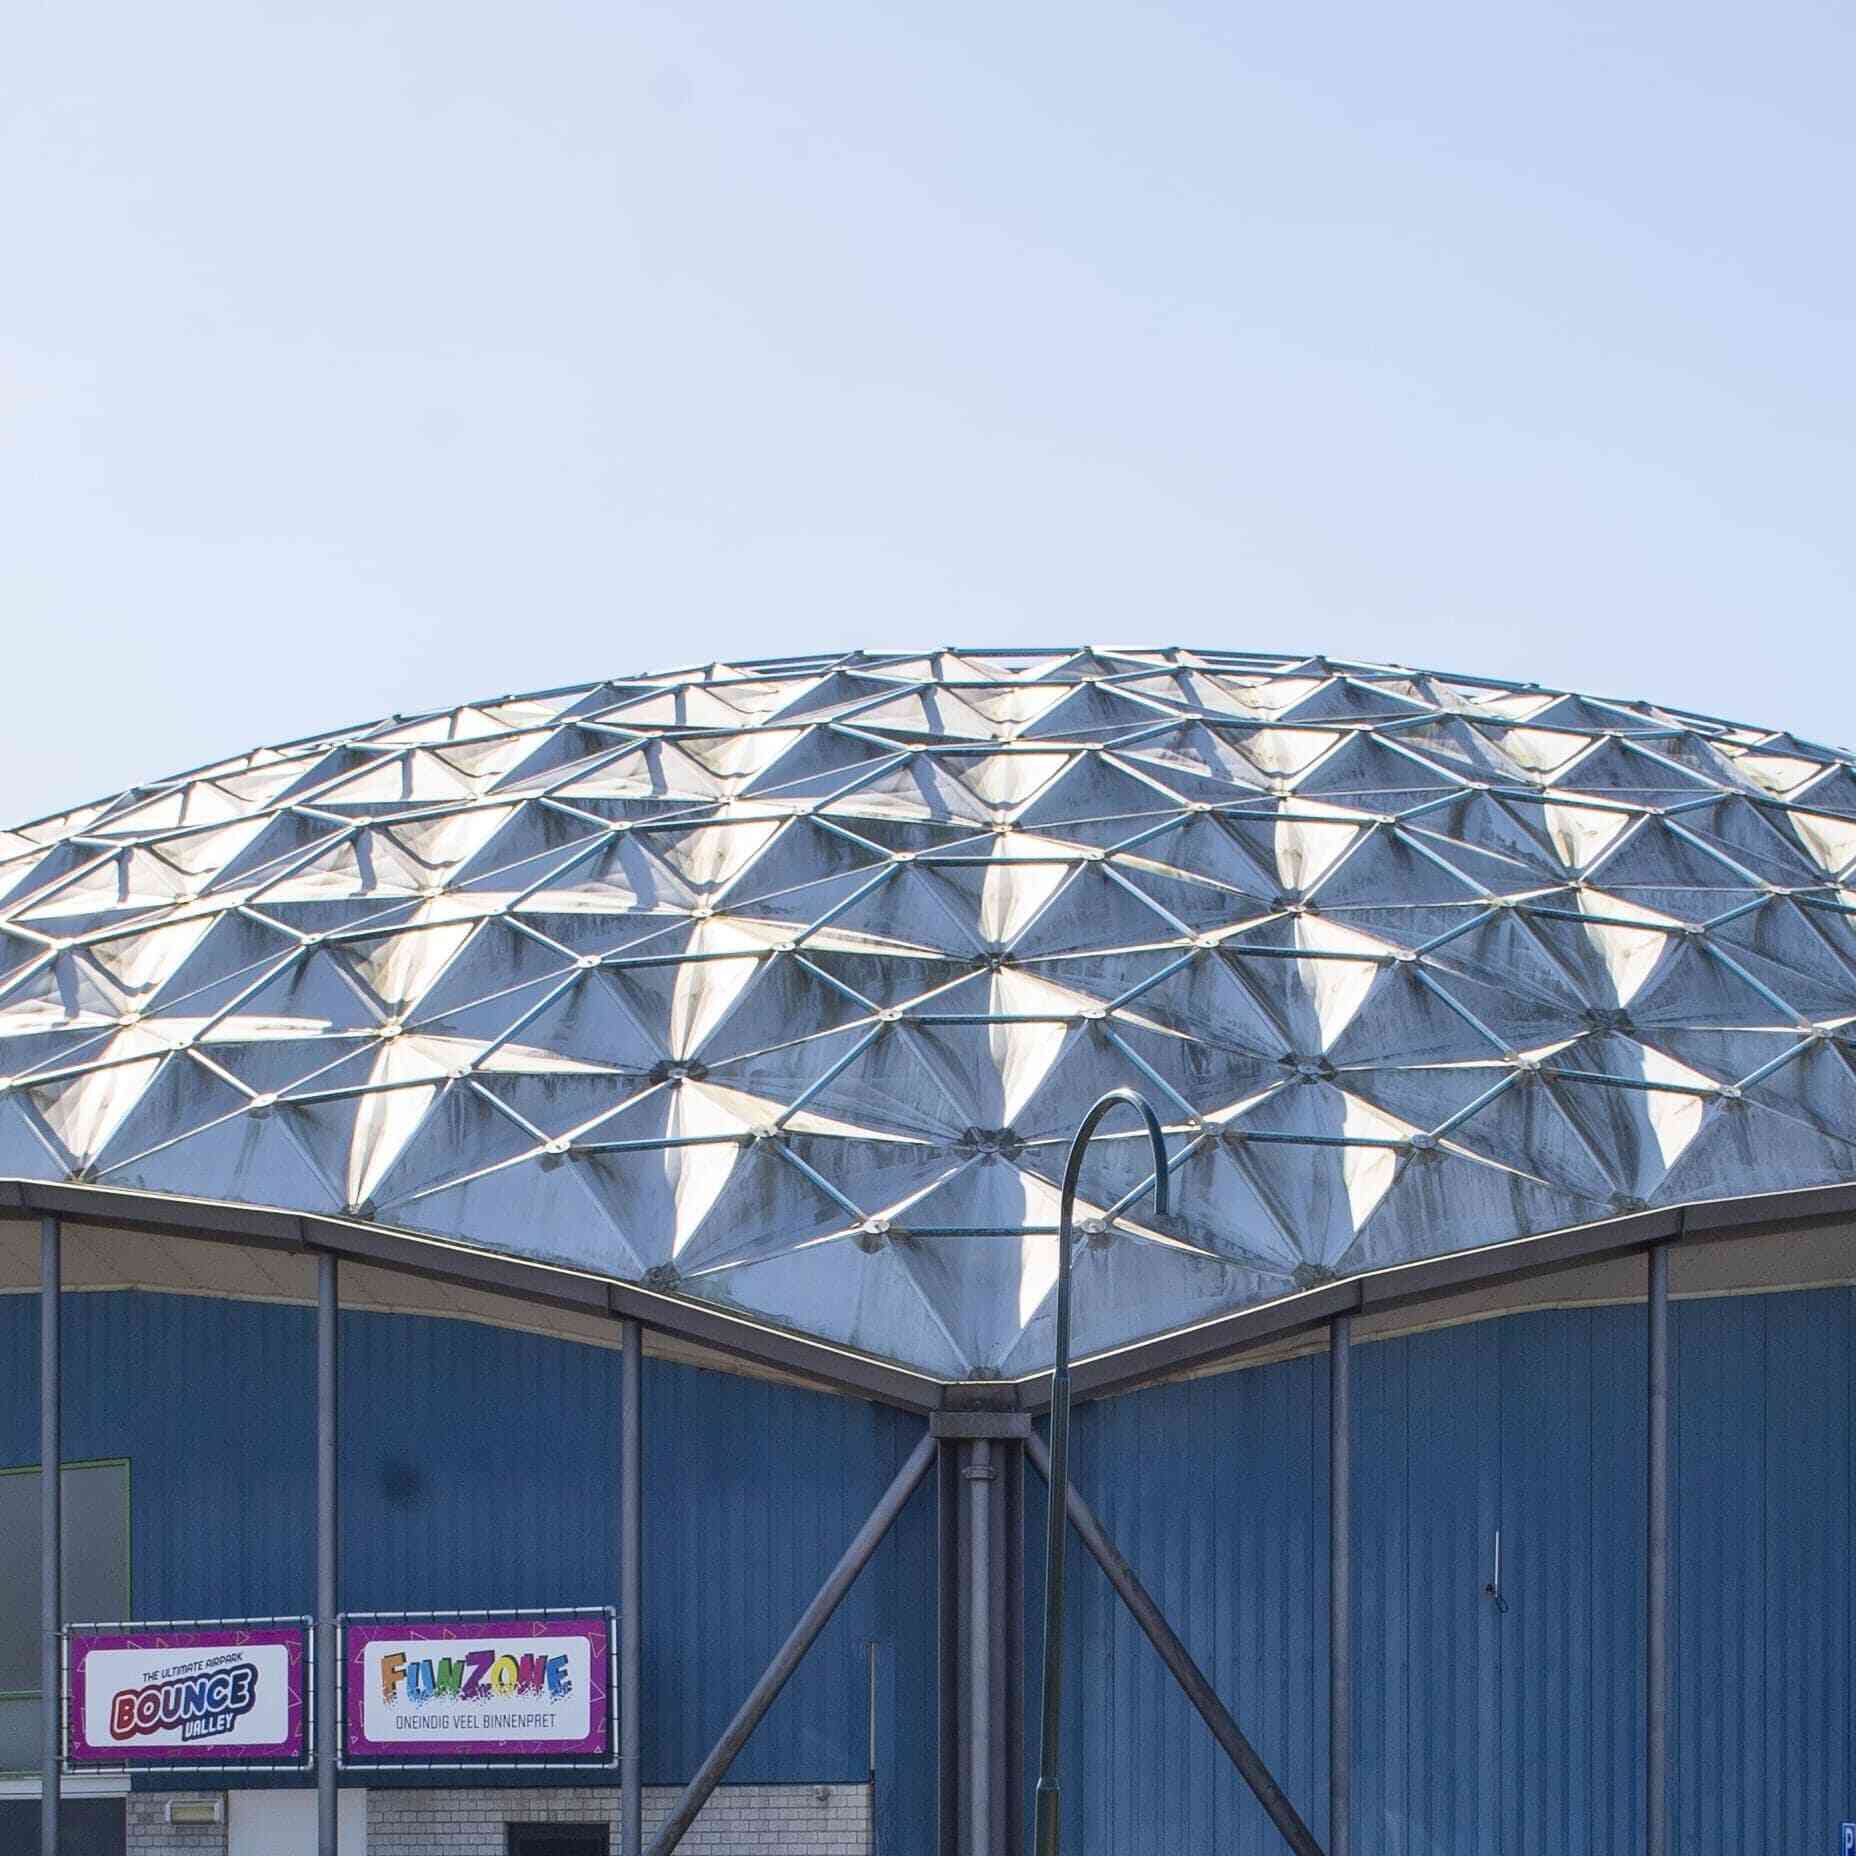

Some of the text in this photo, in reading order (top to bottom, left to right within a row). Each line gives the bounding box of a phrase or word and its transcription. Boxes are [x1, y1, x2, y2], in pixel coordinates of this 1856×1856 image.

[142, 1671, 158, 1682] THE
[161, 1661, 203, 1680] ULTIMATE
[113, 1667, 253, 1734] BOUNCE
[184, 1712, 234, 1738] VALLEY
[396, 1712, 557, 1729] ONEINDIG VEEL BINNENPRET
